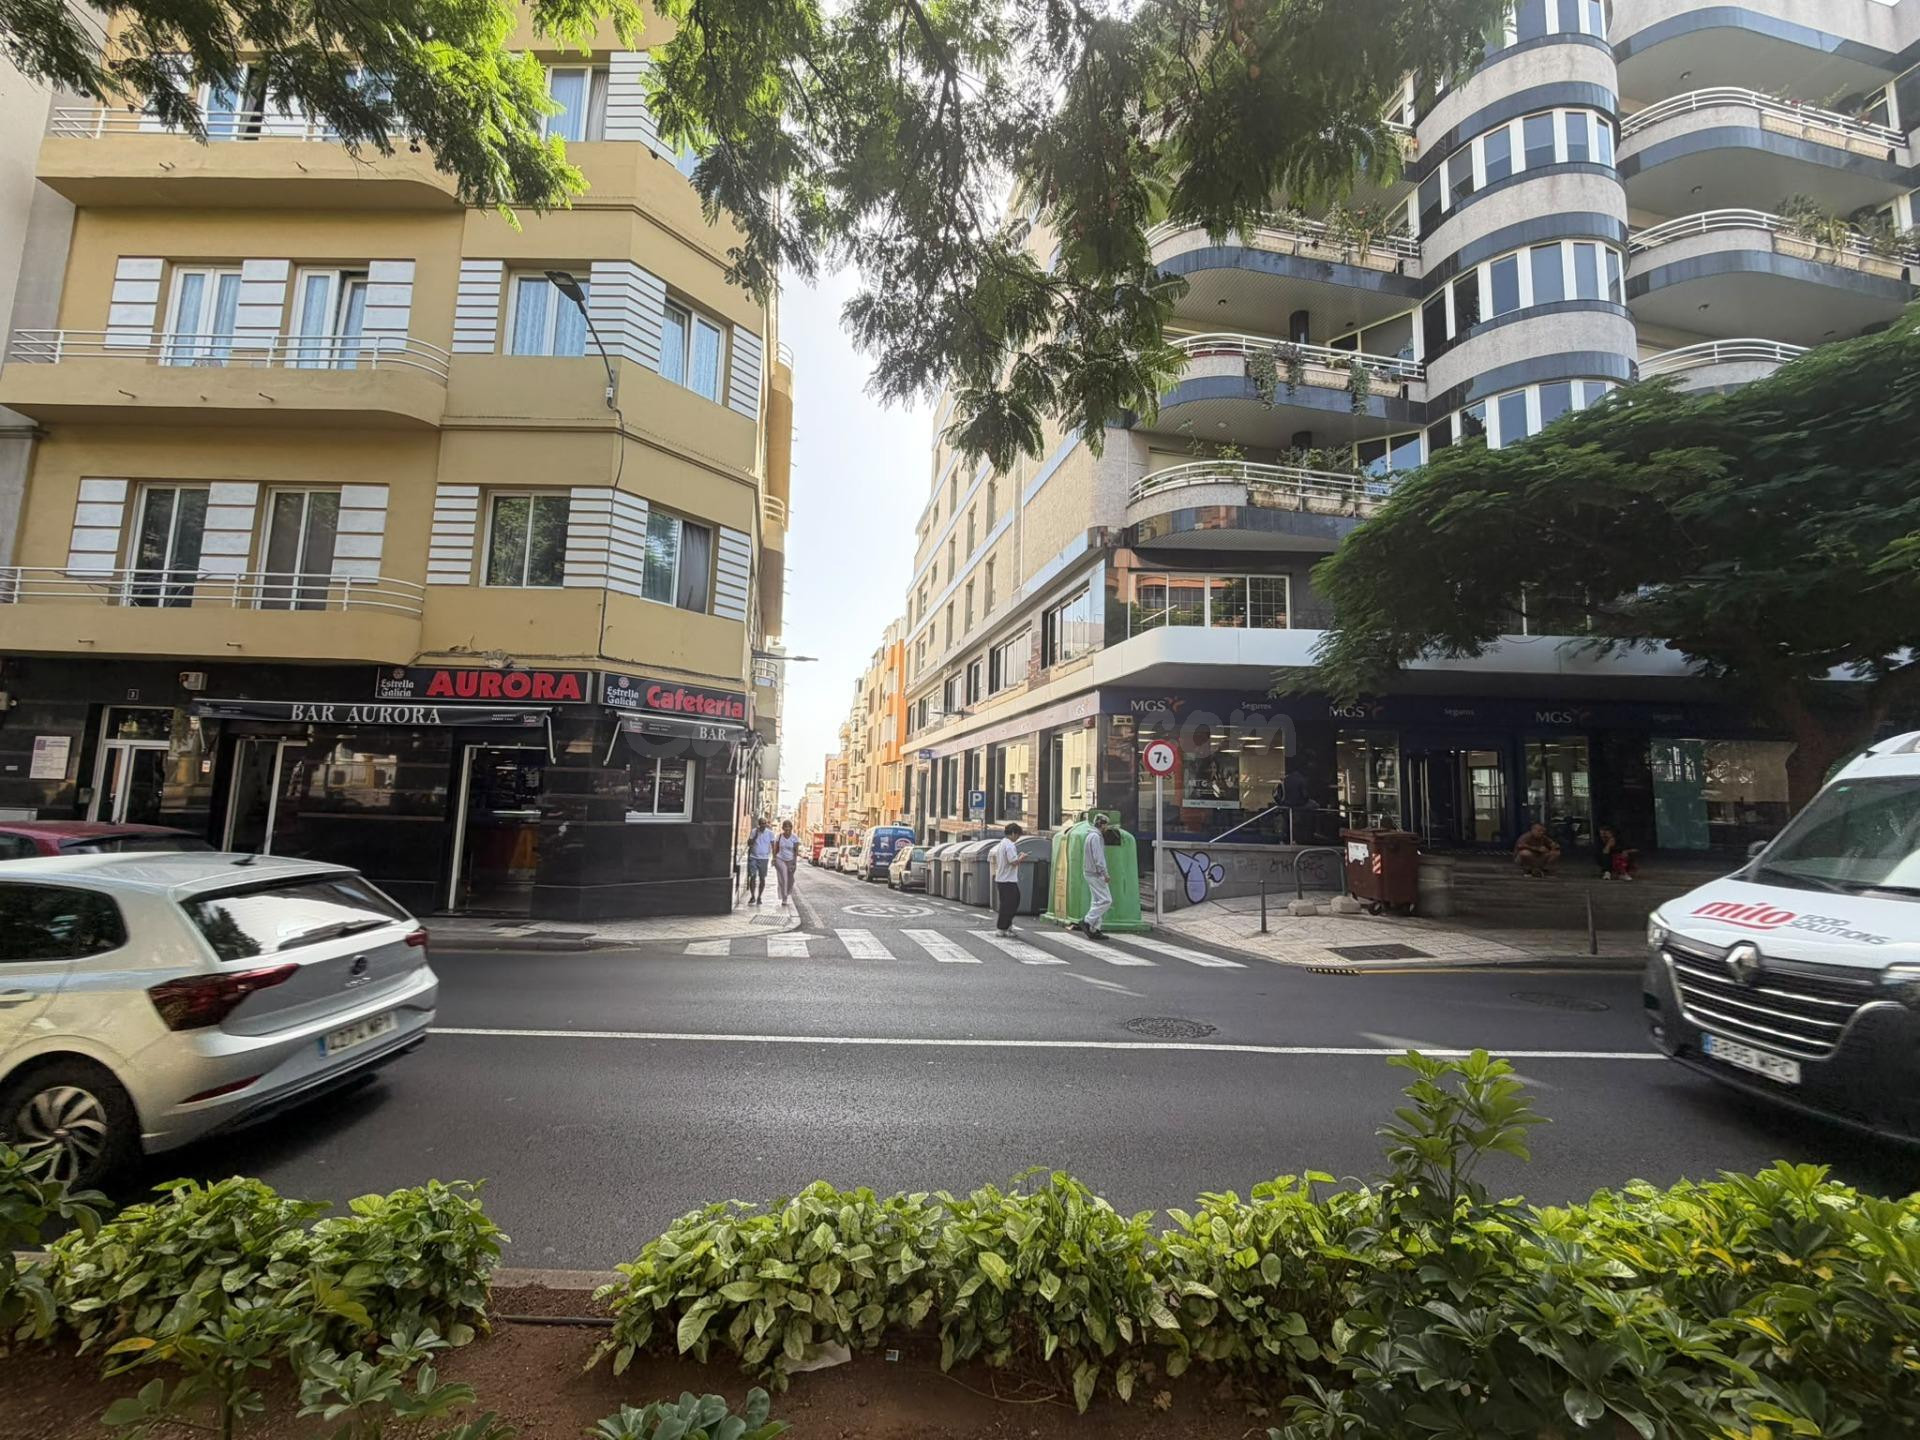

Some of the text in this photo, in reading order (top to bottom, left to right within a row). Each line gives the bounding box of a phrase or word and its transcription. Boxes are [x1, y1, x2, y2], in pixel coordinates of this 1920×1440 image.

[381, 679, 415, 689] Estrella
[426, 671, 581, 699] AURORA
[381, 687, 412, 697] Galicia
[606, 686, 639, 699] Estrella
[607, 695, 637, 707] Galicia
[646, 685, 745, 718] Cafetería
[1130, 700, 1166, 712] MGS
[290, 705, 441, 724] BAR AURORA
[1328, 705, 1366, 718] MGS
[1535, 711, 1573, 723] MGS
[699, 727, 727, 740] BAR
[972, 792, 983, 807] P
[1800, 914, 1851, 926] FOOD
[1785, 921, 1892, 945] SOLUTIONS
